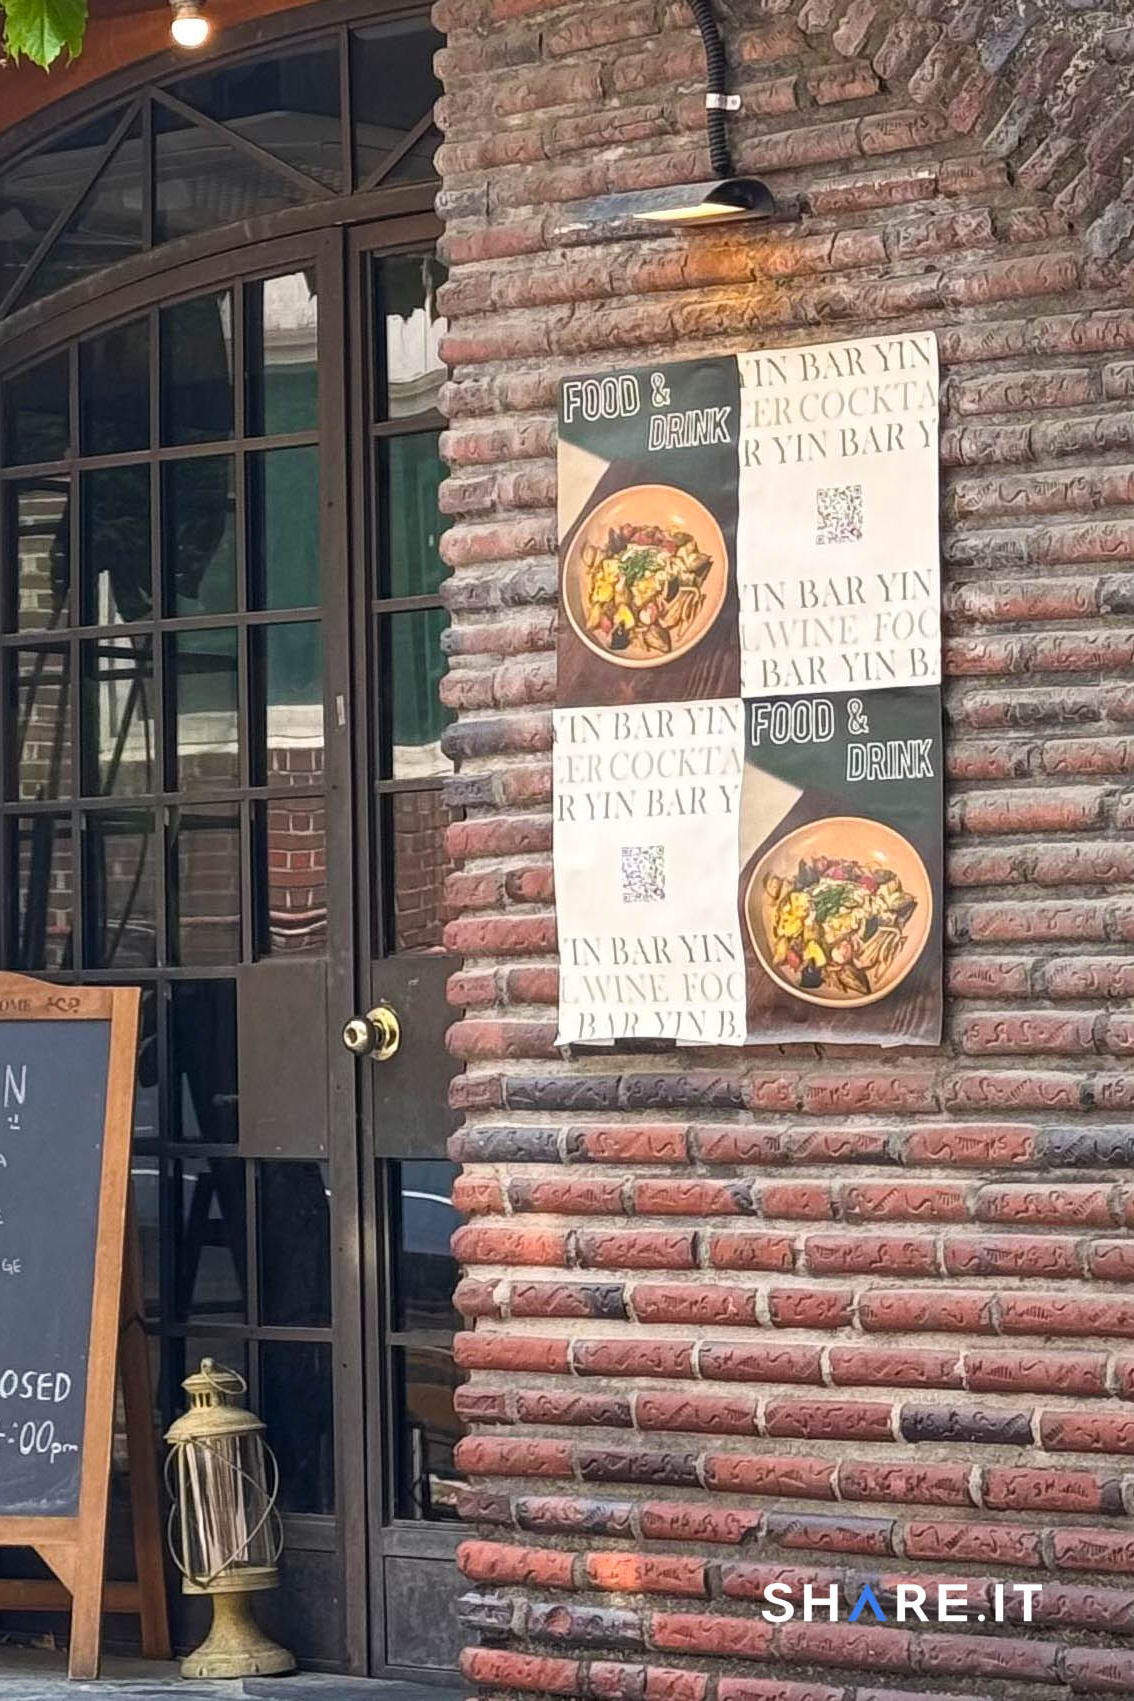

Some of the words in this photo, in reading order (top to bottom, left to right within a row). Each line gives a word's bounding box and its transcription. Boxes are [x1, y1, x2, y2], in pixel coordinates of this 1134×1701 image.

[800, 347, 866, 382] BAR
[873, 337, 932, 372] YIN
[563, 375, 640, 423] FOOD
[650, 372, 671, 406] &
[648, 406, 732, 451] DRINK
[744, 438, 762, 467] R
[772, 429, 827, 464] YIN
[840, 423, 905, 457] BAR
[799, 576, 867, 609] BAR
[877, 568, 933, 603] YIN
[763, 615, 858, 648] WINE
[761, 656, 827, 688] BAR
[842, 650, 896, 683] YIN
[614, 709, 674, 740] BAR
[684, 704, 739, 736] YIN
[751, 699, 834, 745] FOOD
[847, 698, 869, 735] &
[846, 739, 935, 781] DRINK
[558, 794, 576, 822] R
[586, 790, 636, 820] YIN
[647, 787, 706, 816] BAR
[611, 935, 672, 965] BAR
[679, 933, 735, 963] YIN
[582, 973, 669, 1003] WINE
[579, 1012, 639, 1038] BAR
[655, 1010, 706, 1037] YIN
